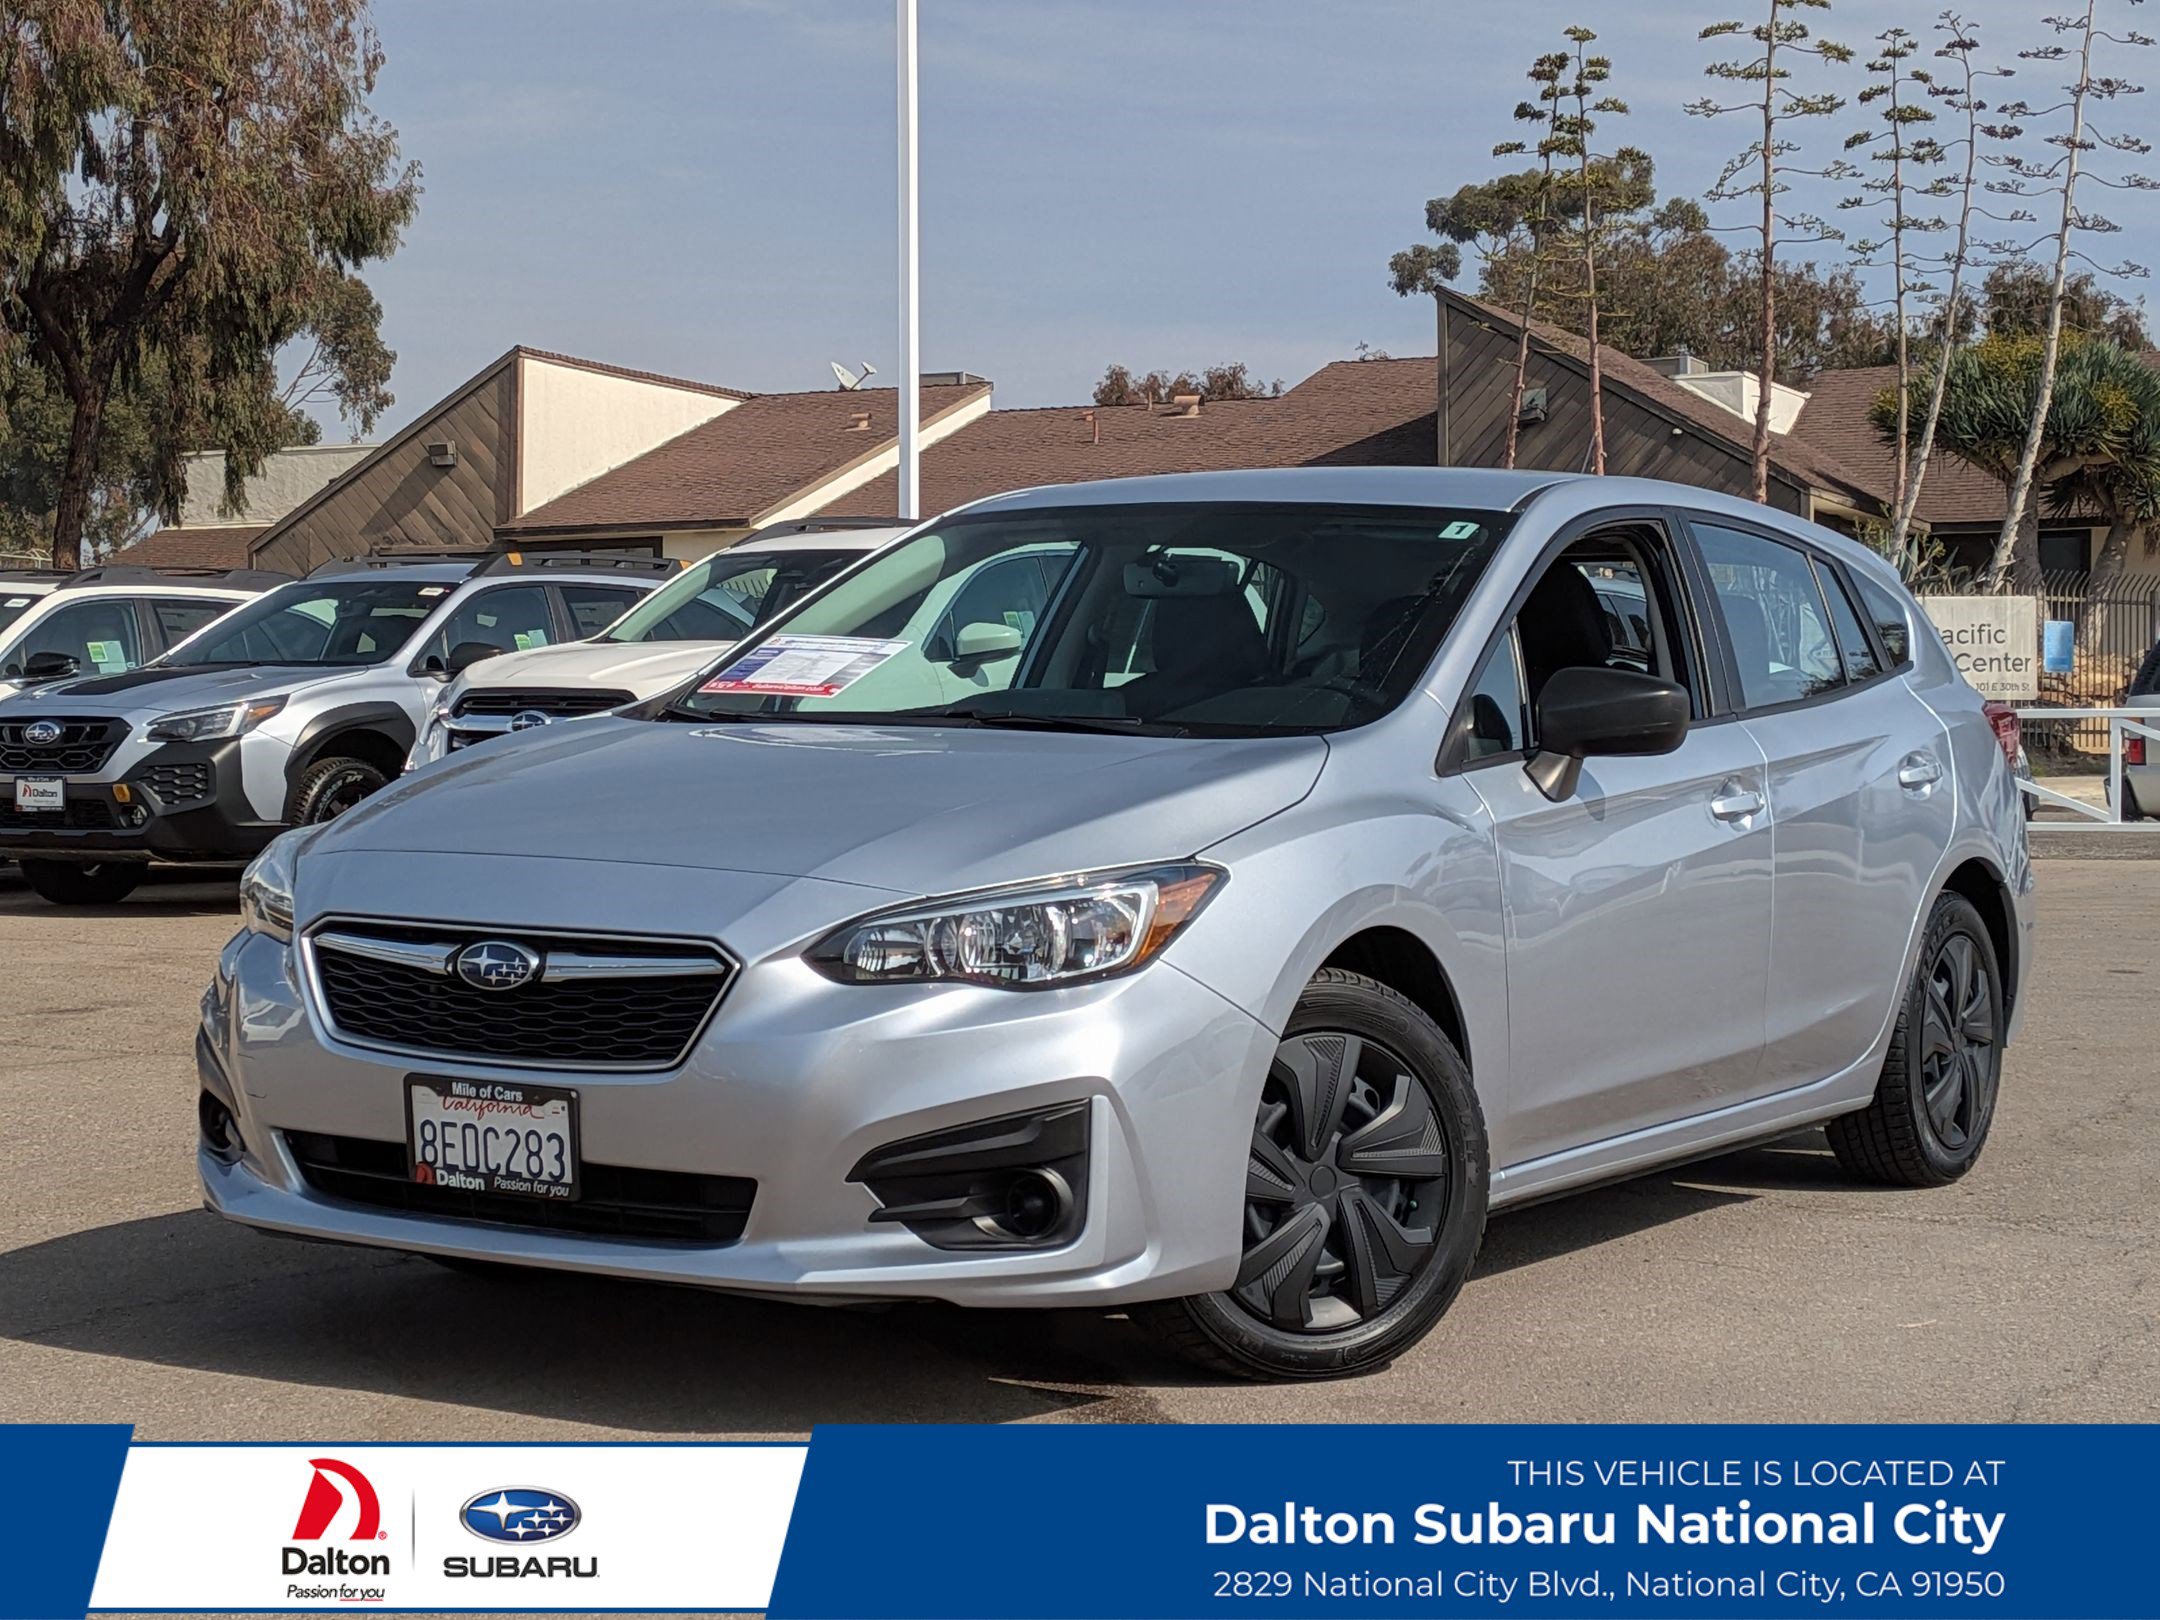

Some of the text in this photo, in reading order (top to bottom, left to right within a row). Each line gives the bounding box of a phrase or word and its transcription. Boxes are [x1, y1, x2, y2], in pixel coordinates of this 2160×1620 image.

[1454, 524, 1469, 535] 1
[1936, 624, 2006, 645] acific
[1954, 652, 2031, 672] Center
[1992, 682, 1998, 691] E
[2000, 682, 2020, 691] 30th
[452, 1082, 523, 1102] Mile of Cars
[436, 1169, 569, 1197] Dalton Passion for you
